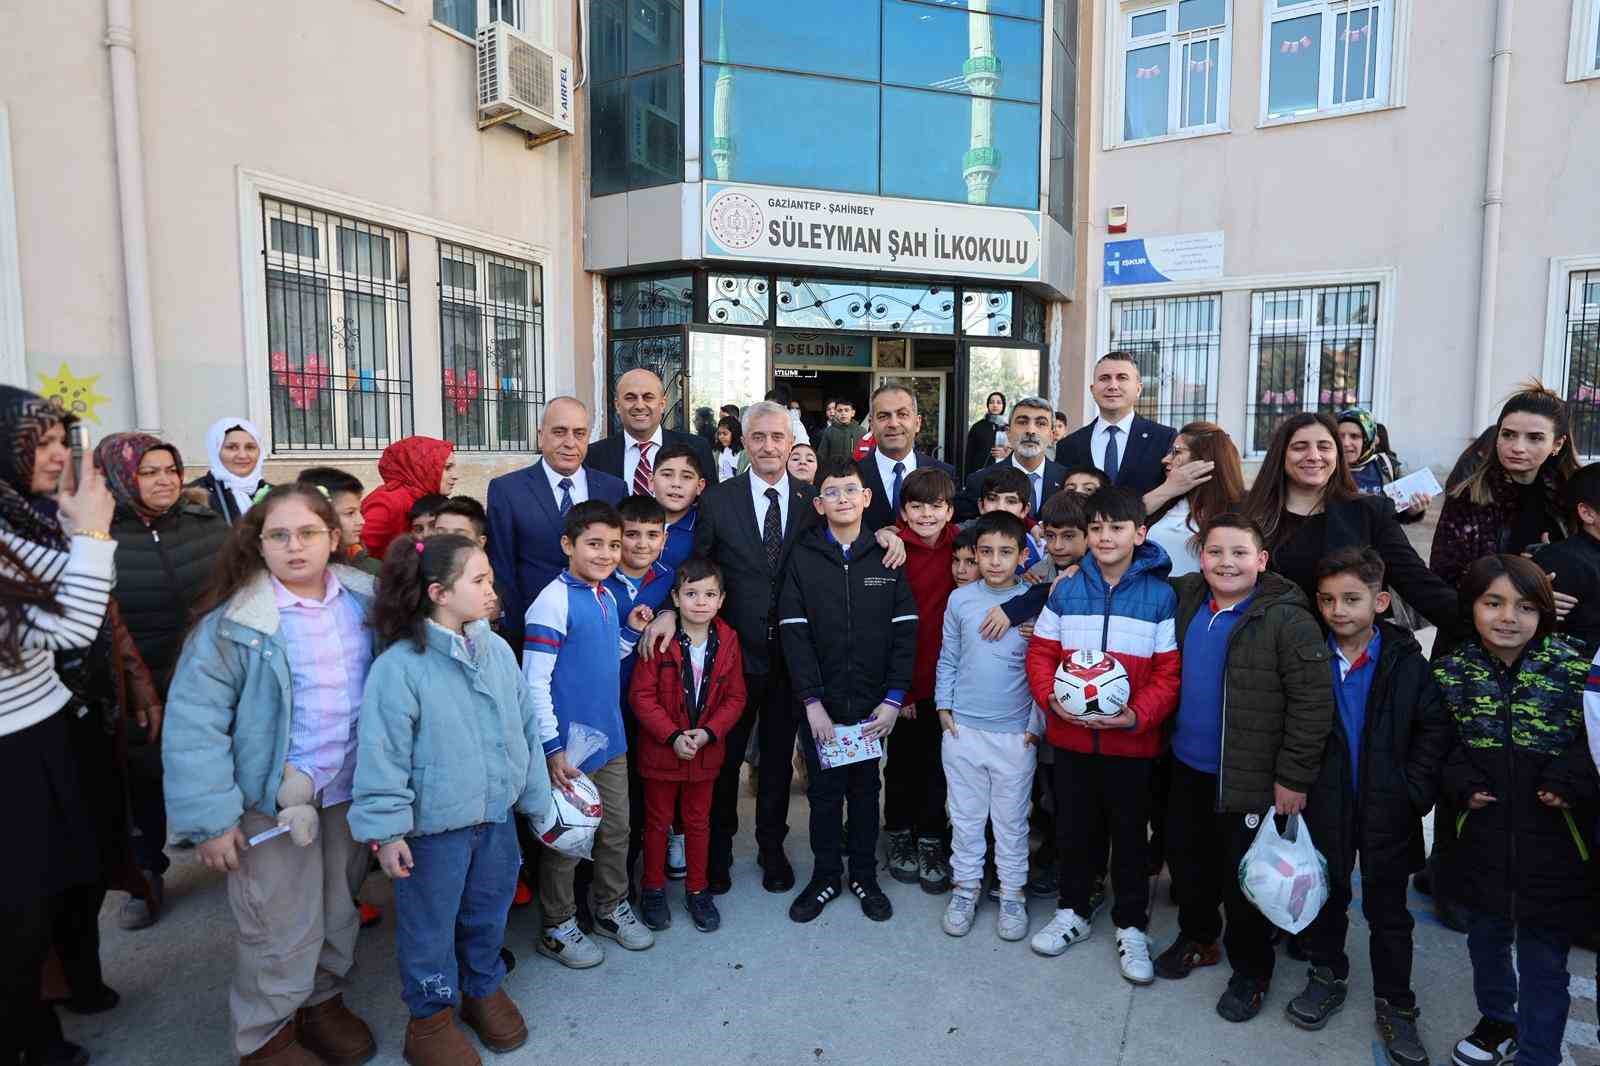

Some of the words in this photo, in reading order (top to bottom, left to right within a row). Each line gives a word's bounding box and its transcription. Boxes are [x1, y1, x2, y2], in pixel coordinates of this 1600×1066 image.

[560, 67, 568, 111] AIRFEL
[768, 197, 822, 211] GAZİANTEP
[828, 203, 875, 216] ŞAHİNBEY
[768, 215, 881, 254] SÜLEYMAN
[888, 229, 927, 262] ŞAH
[934, 227, 1029, 264] İLKOKULU
